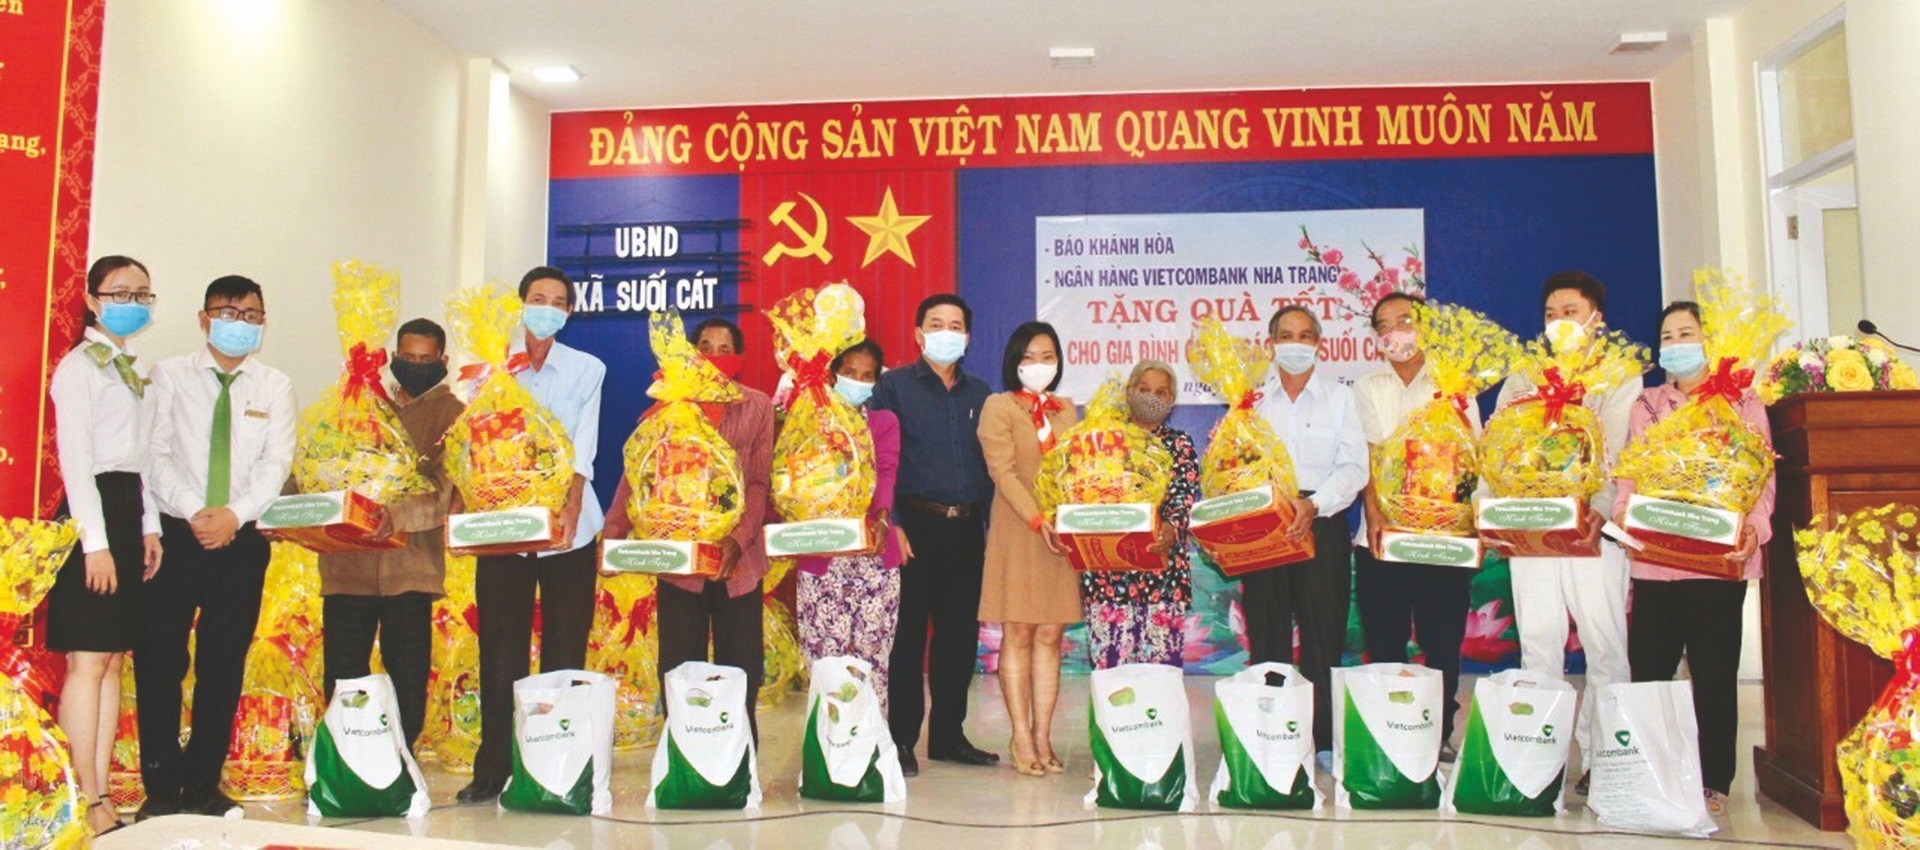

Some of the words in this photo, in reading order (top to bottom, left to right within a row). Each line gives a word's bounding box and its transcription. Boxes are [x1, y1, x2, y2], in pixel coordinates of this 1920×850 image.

[589, 111, 692, 166] ĐẢNG
[705, 112, 808, 171] CỘNG
[822, 104, 897, 160] SẢN
[909, 105, 1002, 165] VIỆT
[1015, 112, 1102, 154] NAM
[1115, 107, 1250, 158] QUANG
[1262, 103, 1363, 147] VINH
[1377, 93, 1492, 145] MUÔN
[1507, 91, 1598, 143] NĂM
[615, 226, 678, 258] UBND
[1054, 234, 1084, 256] BÁO
[1089, 233, 1139, 255] KHÁNH
[1144, 232, 1175, 255] HÒA
[573, 273, 604, 312] XÃ
[616, 268, 667, 312] SUỐI
[676, 269, 718, 310] CÁT
[1054, 265, 1094, 288] NGÂN
[1099, 264, 1138, 287] HÀNG
[1143, 267, 1248, 286] VIETCOMBANK
[1253, 266, 1284, 284] NHA
[1288, 266, 1338, 283] TRANG
[1087, 293, 1178, 330] TẶNG
[1190, 291, 1260, 329] QUÀ
[1067, 340, 1100, 365] CHO
[1106, 340, 1134, 364] GIA
[1139, 334, 1179, 363] ĐÌNH
[1319, 327, 1357, 361] SUỐI
[1111, 720, 1163, 733] Vietcombank
[1503, 732, 1557, 744] Vietcombank
